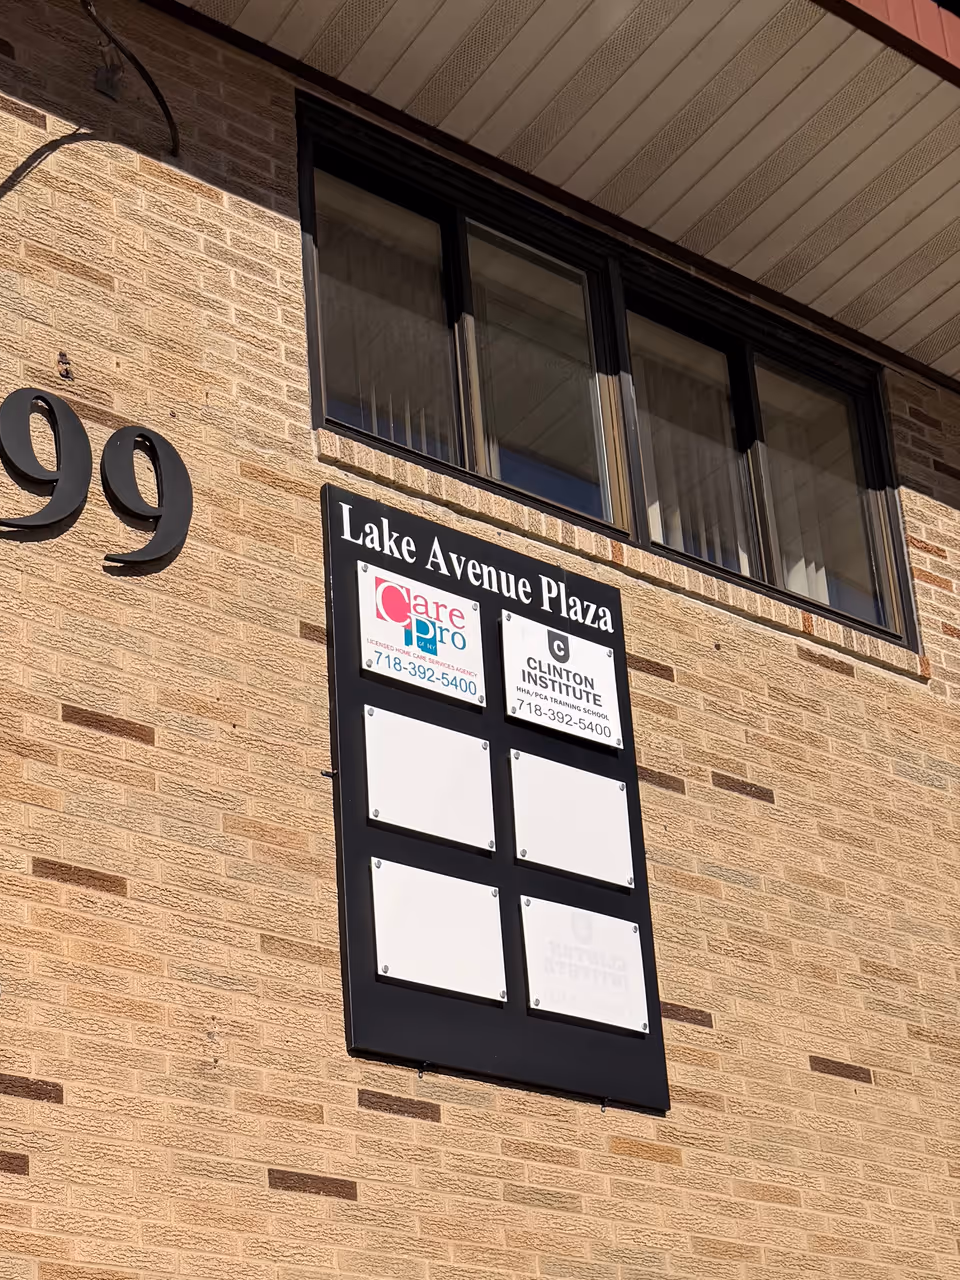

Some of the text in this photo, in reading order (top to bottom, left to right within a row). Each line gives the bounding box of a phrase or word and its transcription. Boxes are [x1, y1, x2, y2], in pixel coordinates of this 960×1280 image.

[339, 502, 614, 633] Lake Avenue Plaza
[375, 580, 465, 630] Care
[407, 613, 467, 651] Pro
[367, 638, 477, 678] LICENSED HOME CARE SERVICES AGENCY
[374, 650, 477, 696] 718-392-5400
[526, 657, 595, 691] CLINTON
[516, 685, 610, 721] HHA/PCA TRAINING SCHOOL
[522, 669, 603, 707] INSTITUTE
[516, 698, 612, 738] 718-392-5400
